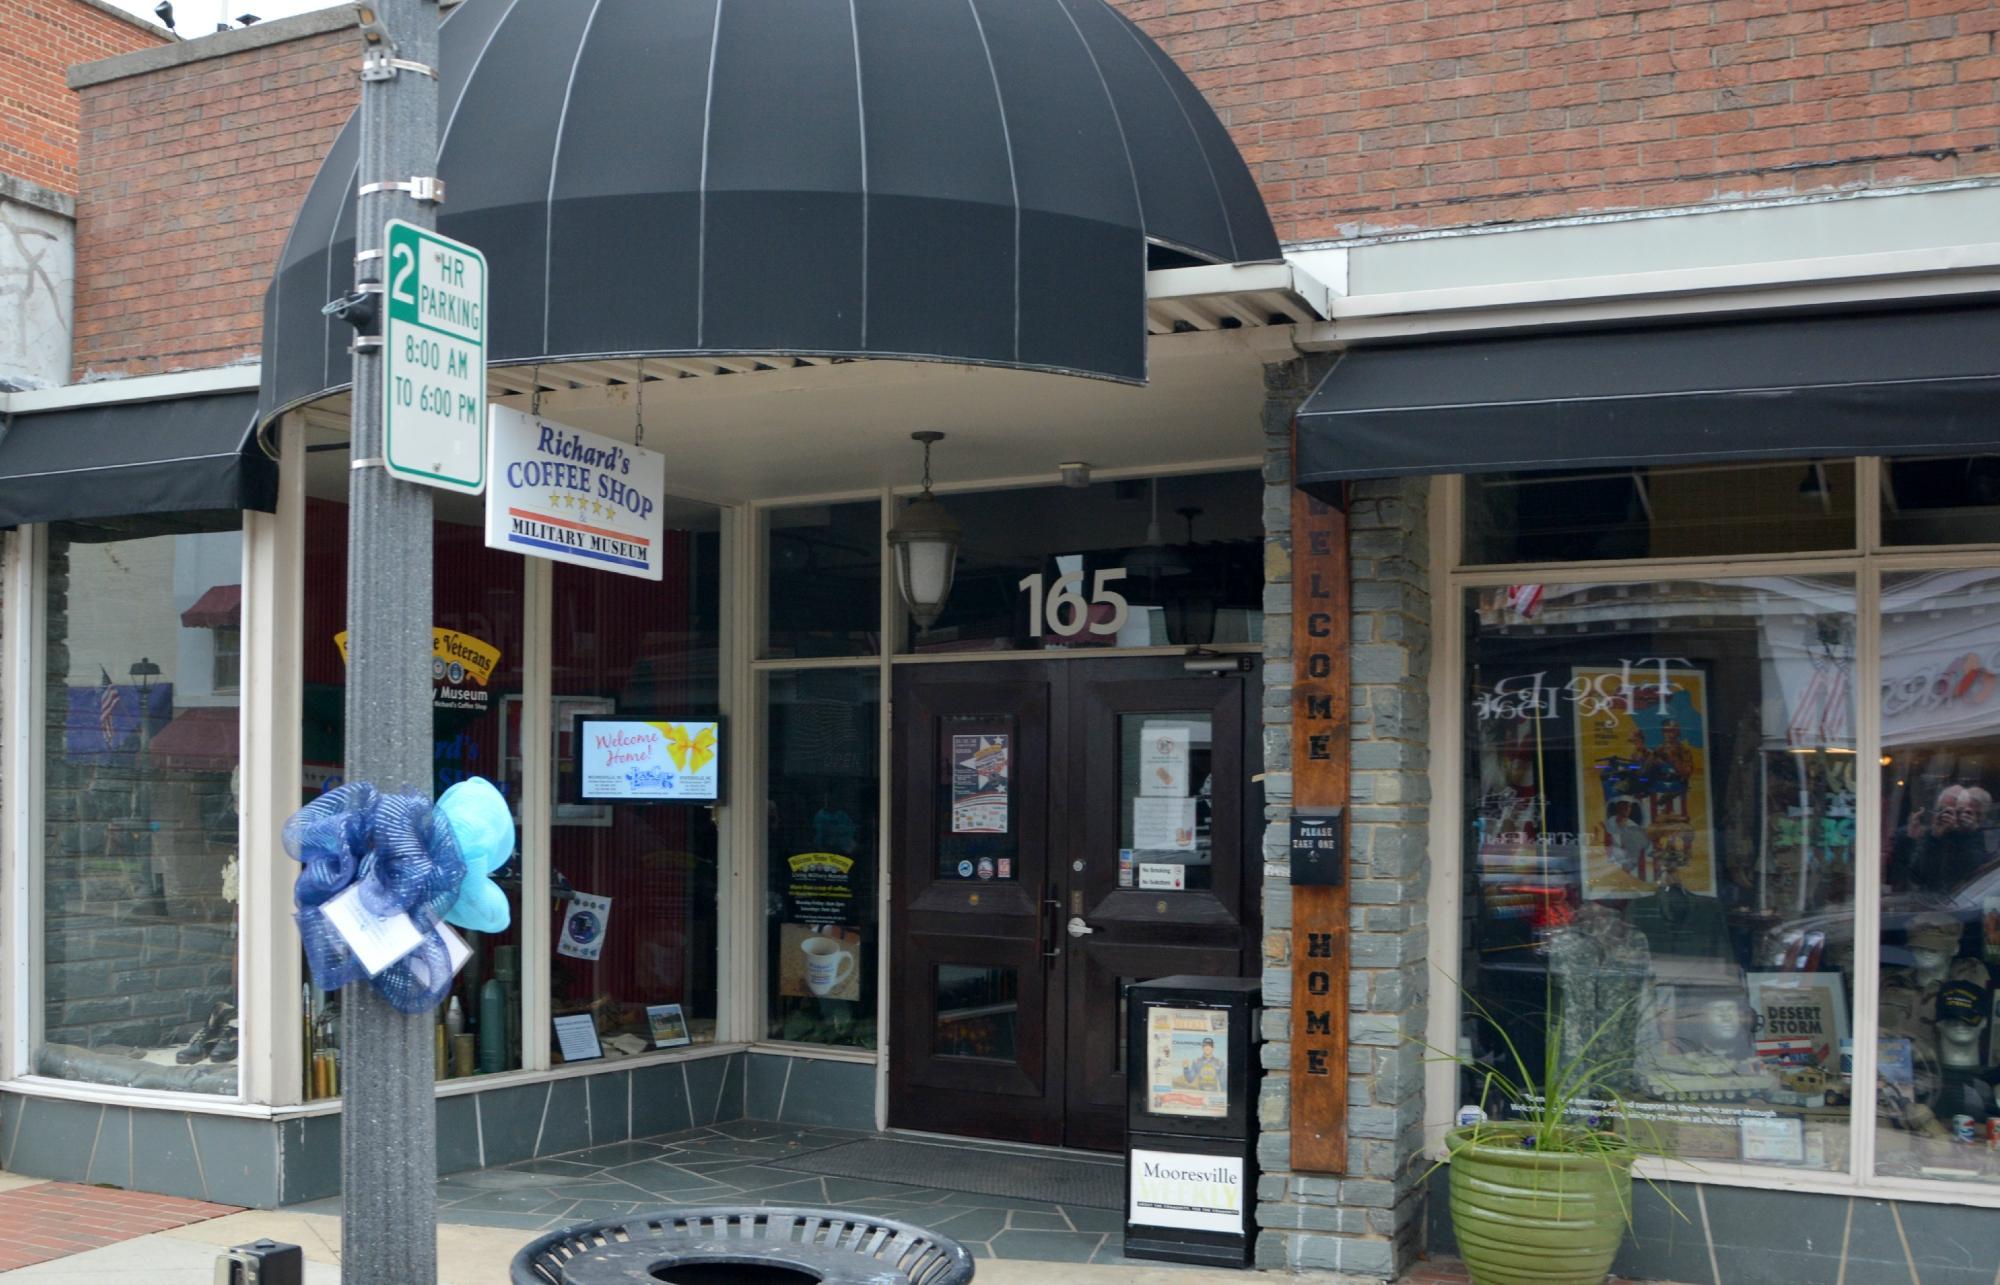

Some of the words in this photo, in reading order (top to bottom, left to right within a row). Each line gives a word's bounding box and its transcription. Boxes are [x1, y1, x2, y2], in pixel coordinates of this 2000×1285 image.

[392, 243, 415, 304] 2
[440, 252, 465, 288] HR
[420, 285, 480, 330] PARKING
[405, 335, 440, 371] 8:00
[447, 348, 468, 380] AM
[395, 376, 413, 407] TO
[420, 384, 452, 417] 6:00
[459, 393, 476, 425] PM
[537, 425, 630, 475] Richard's
[507, 461, 591, 493] COFFEE
[598, 474, 653, 521] SHOP
[512, 518, 585, 548] MILITARY
[590, 533, 648, 561] MUSEUM
[1019, 568, 1128, 637] 165
[443, 634, 491, 671] Veterans
[441, 686, 488, 700] Museum
[596, 729, 658, 749] Welcome
[606, 745, 652, 767] Home!
[1293, 840, 1313, 848] TAKE
[1318, 840, 1334, 849] ONE
[1301, 827, 1333, 836] PLEASE
[1306, 933, 1331, 1075] HOME
[1768, 1006, 1821, 1019] DESERT
[1770, 1020, 1823, 1034] STORM
[1144, 1162, 1237, 1184] Mooresville
[1137, 1178, 1237, 1209] WEEKLY
